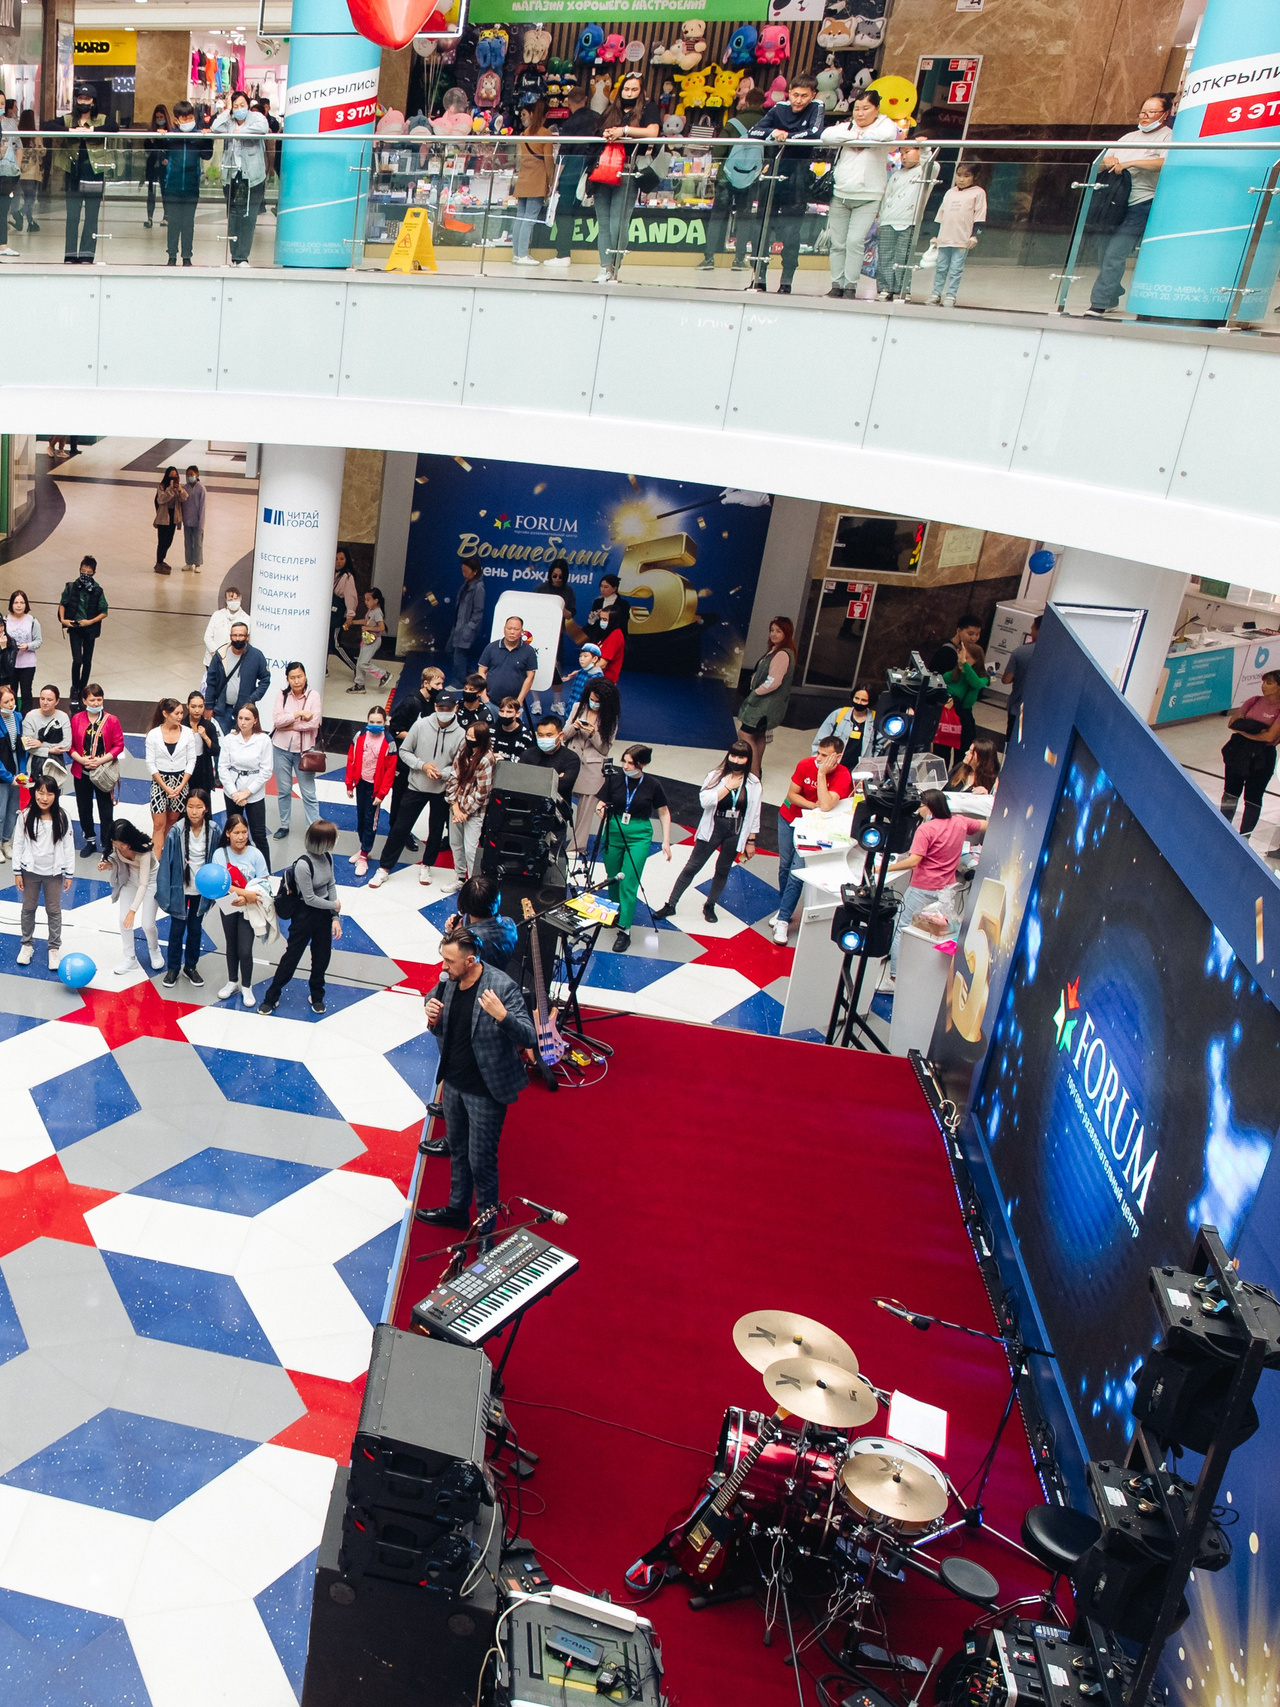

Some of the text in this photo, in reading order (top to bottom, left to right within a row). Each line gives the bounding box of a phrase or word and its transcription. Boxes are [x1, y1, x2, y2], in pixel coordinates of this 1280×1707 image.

[566, 0, 630, 11] ХОРОШЕГО
[631, 0, 706, 11] НАСТРОЕНИЯ
[304, 78, 377, 101] ОТКРЫЛИСЬ
[1247, 100, 1280, 120] ЭТ
[628, 217, 707, 246] ANDA
[287, 510, 319, 520] ЧИТАЙ
[287, 519, 319, 529] ГОРОД
[515, 515, 578, 533] FORUM
[260, 552, 317, 565] БЕСТСЕЛЛЕРЫ
[259, 569, 299, 582] НОВИНКИ
[481, 566, 509, 578] ень
[258, 586, 297, 599] ПОДАРКИ
[257, 603, 311, 616] КАНЦЕЛЯРИЯ
[256, 621, 281, 632] КНИГИ
[267, 657, 293, 670] ТАЖ
[1073, 1011, 1158, 1216] FORUM
[1066, 1072, 1140, 1239] торгово-развлекательный центр
